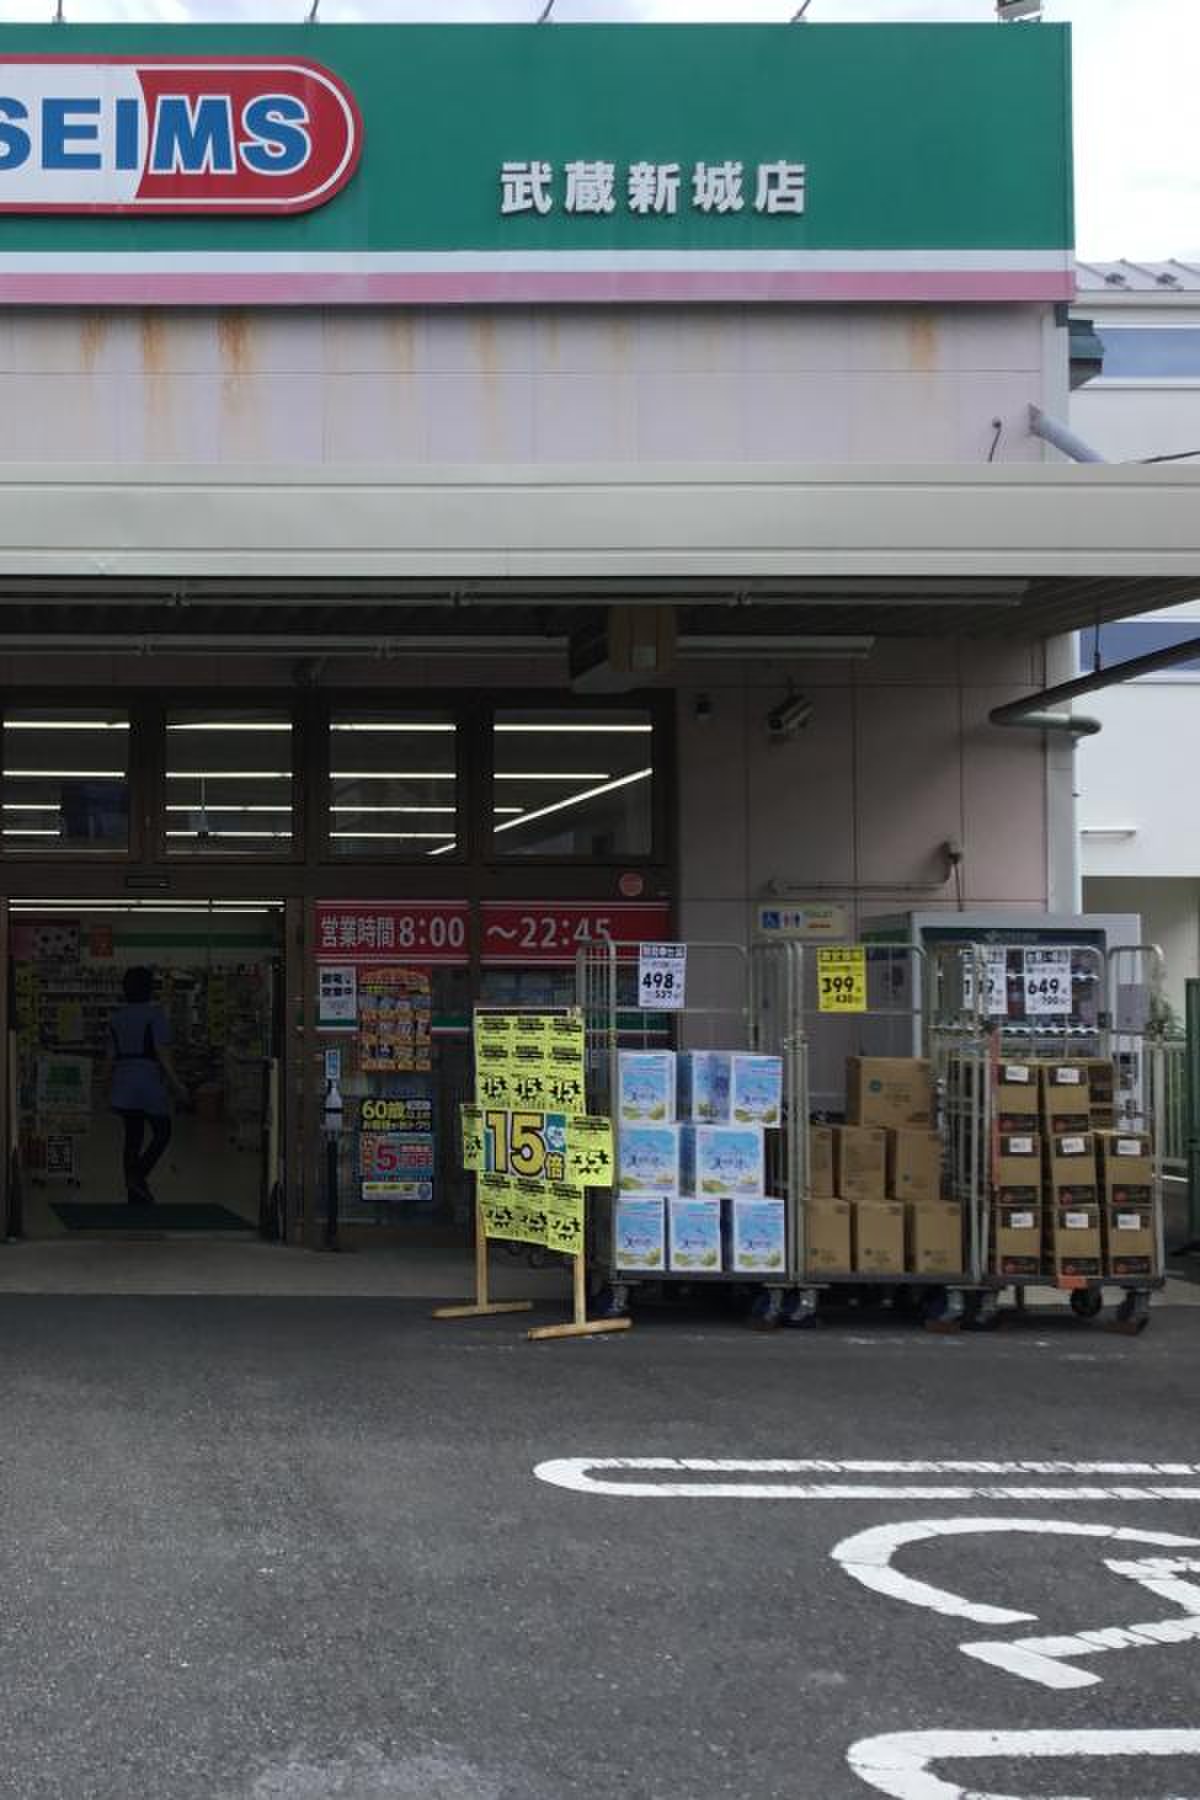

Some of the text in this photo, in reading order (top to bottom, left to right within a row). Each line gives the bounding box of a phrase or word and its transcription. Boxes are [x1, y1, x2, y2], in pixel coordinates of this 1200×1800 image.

[499, 159, 808, 216] 武蔵新城店
[642, 972, 674, 988] 498
[821, 976, 854, 992] 399
[1028, 978, 1059, 994] 649
